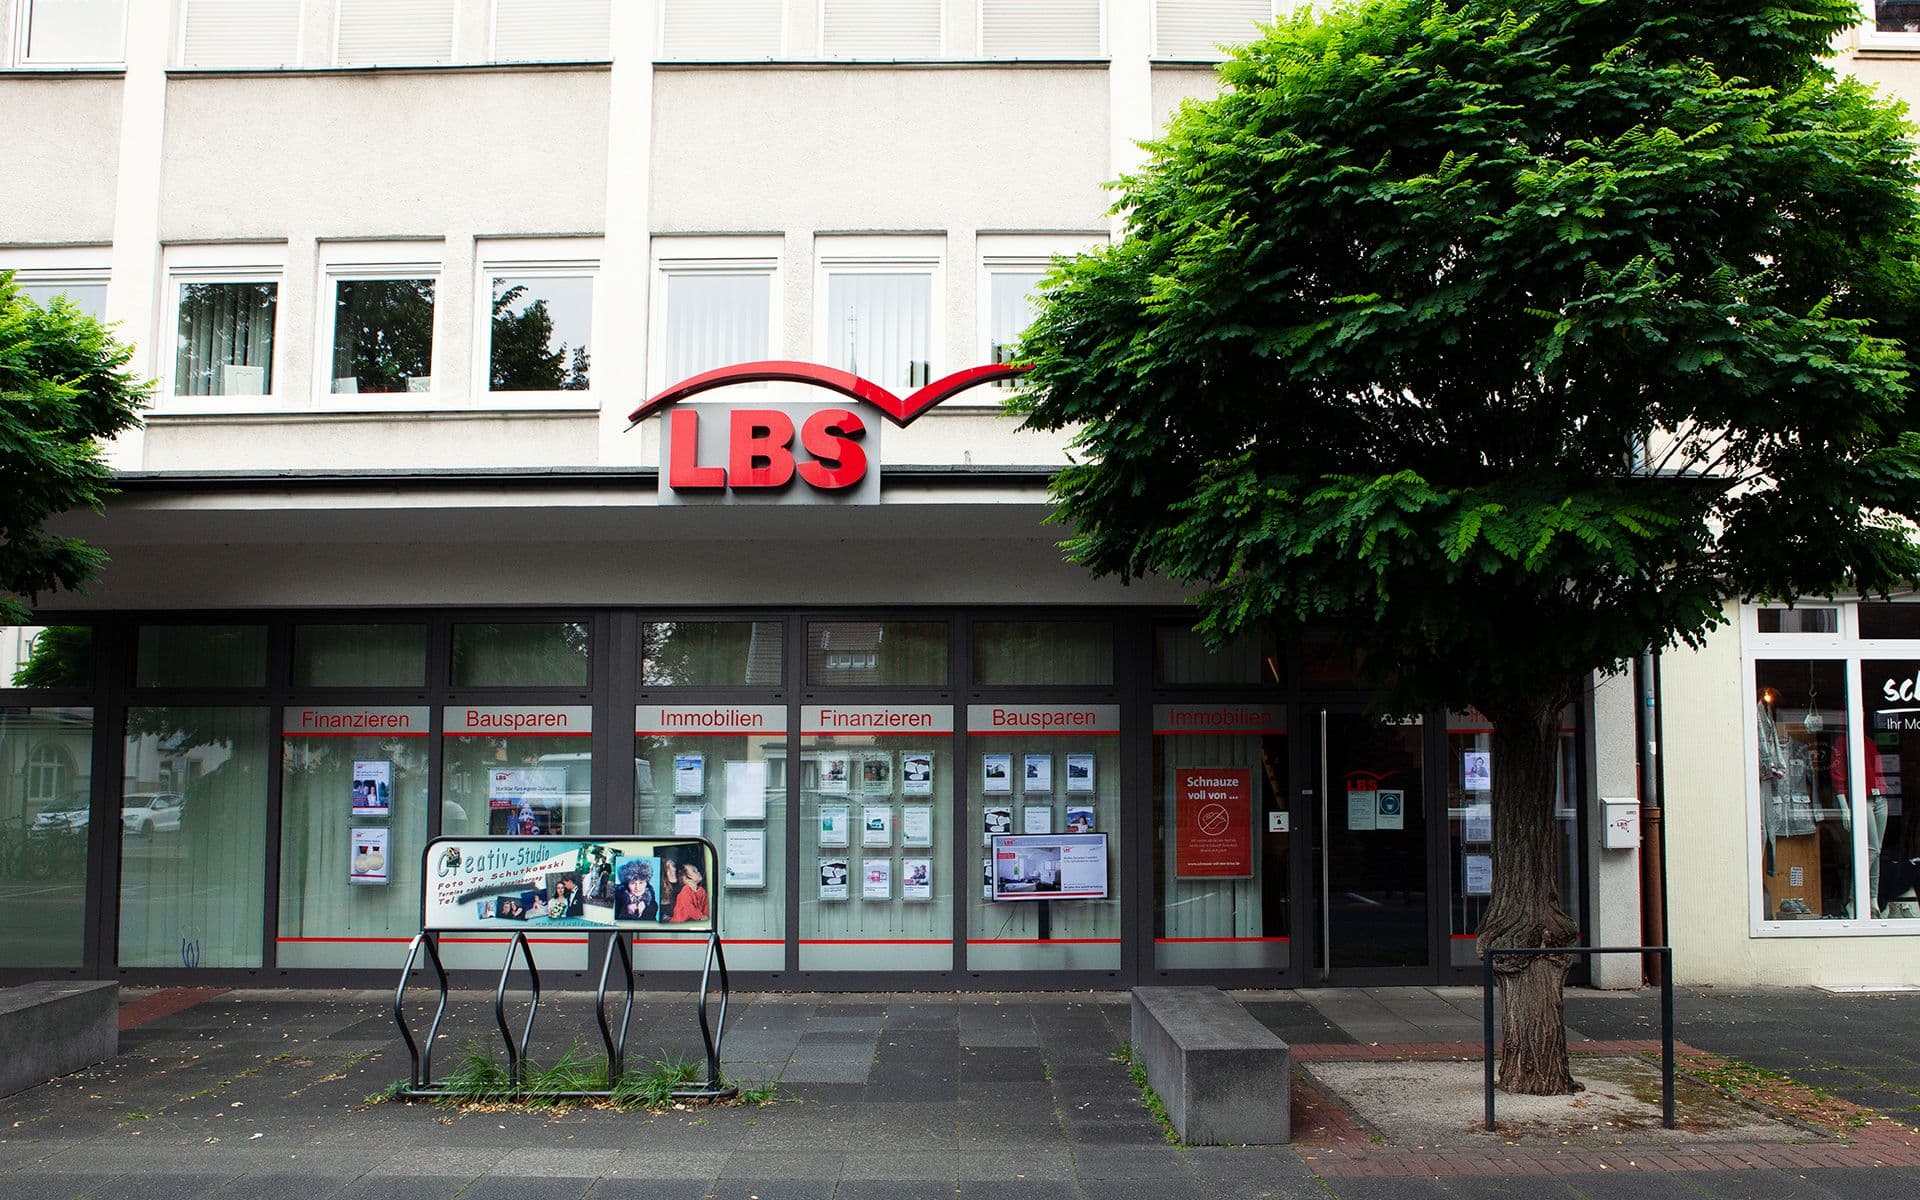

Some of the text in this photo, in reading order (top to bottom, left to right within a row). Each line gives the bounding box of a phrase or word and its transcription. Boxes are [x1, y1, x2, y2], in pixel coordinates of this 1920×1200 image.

[670, 408, 868, 493] LBS
[302, 711, 409, 728] Finanzieren
[467, 710, 567, 730] Bausparen
[661, 710, 763, 727] Immobilien
[820, 710, 932, 727] Finanzieren
[993, 709, 1096, 729] Bausparen
[1169, 709, 1273, 725] Immobilien
[1887, 718, 1902, 730] Ihr
[1187, 776, 1239, 787] Schnauze
[1187, 790, 1206, 800] voll
[1208, 792, 1227, 800] von
[437, 860, 564, 890] Foto Jo Schutkowski
